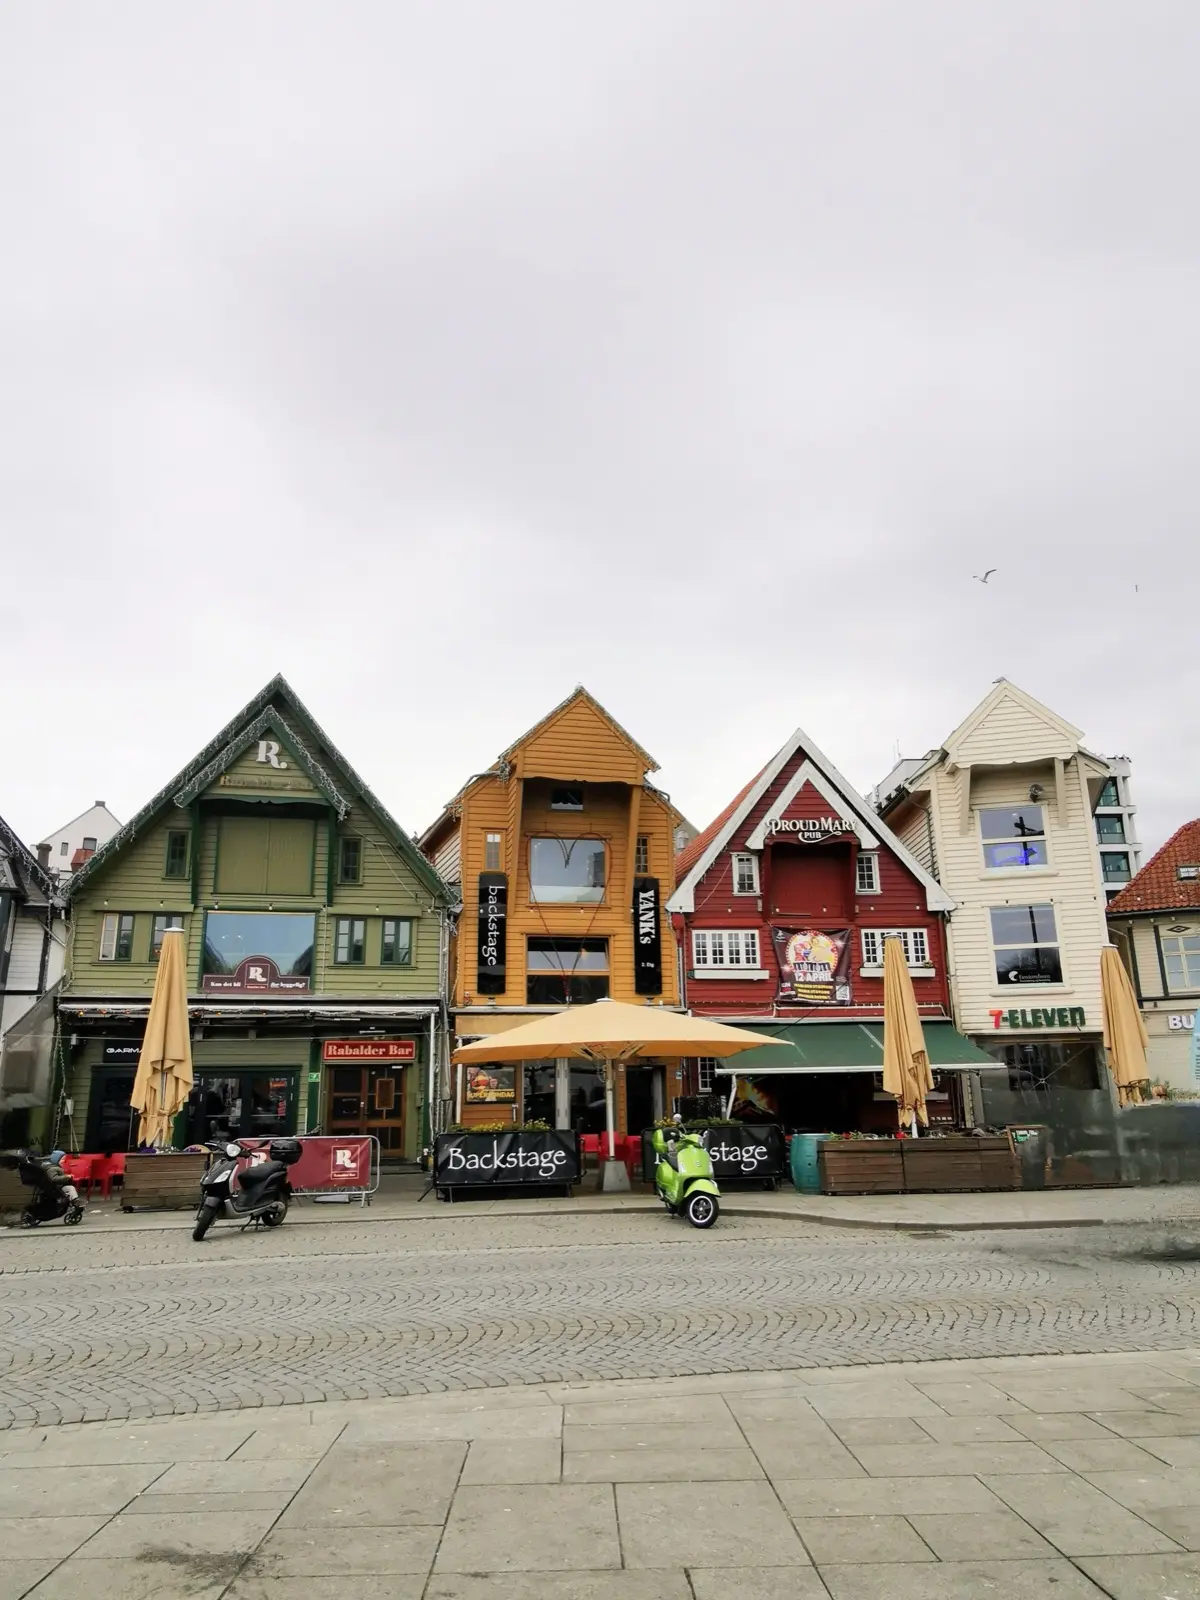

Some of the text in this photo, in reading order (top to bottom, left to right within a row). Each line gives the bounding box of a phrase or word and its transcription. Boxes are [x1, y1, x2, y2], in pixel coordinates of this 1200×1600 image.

[765, 817, 857, 836] PROUD MARY
[804, 831, 822, 839] PUB
[481, 885, 506, 966] backstage
[794, 971, 835, 982] 12 APRIL
[328, 1044, 412, 1056] Rabalder Bar
[335, 1149, 357, 1168] R
[448, 1140, 567, 1177] Backstage
